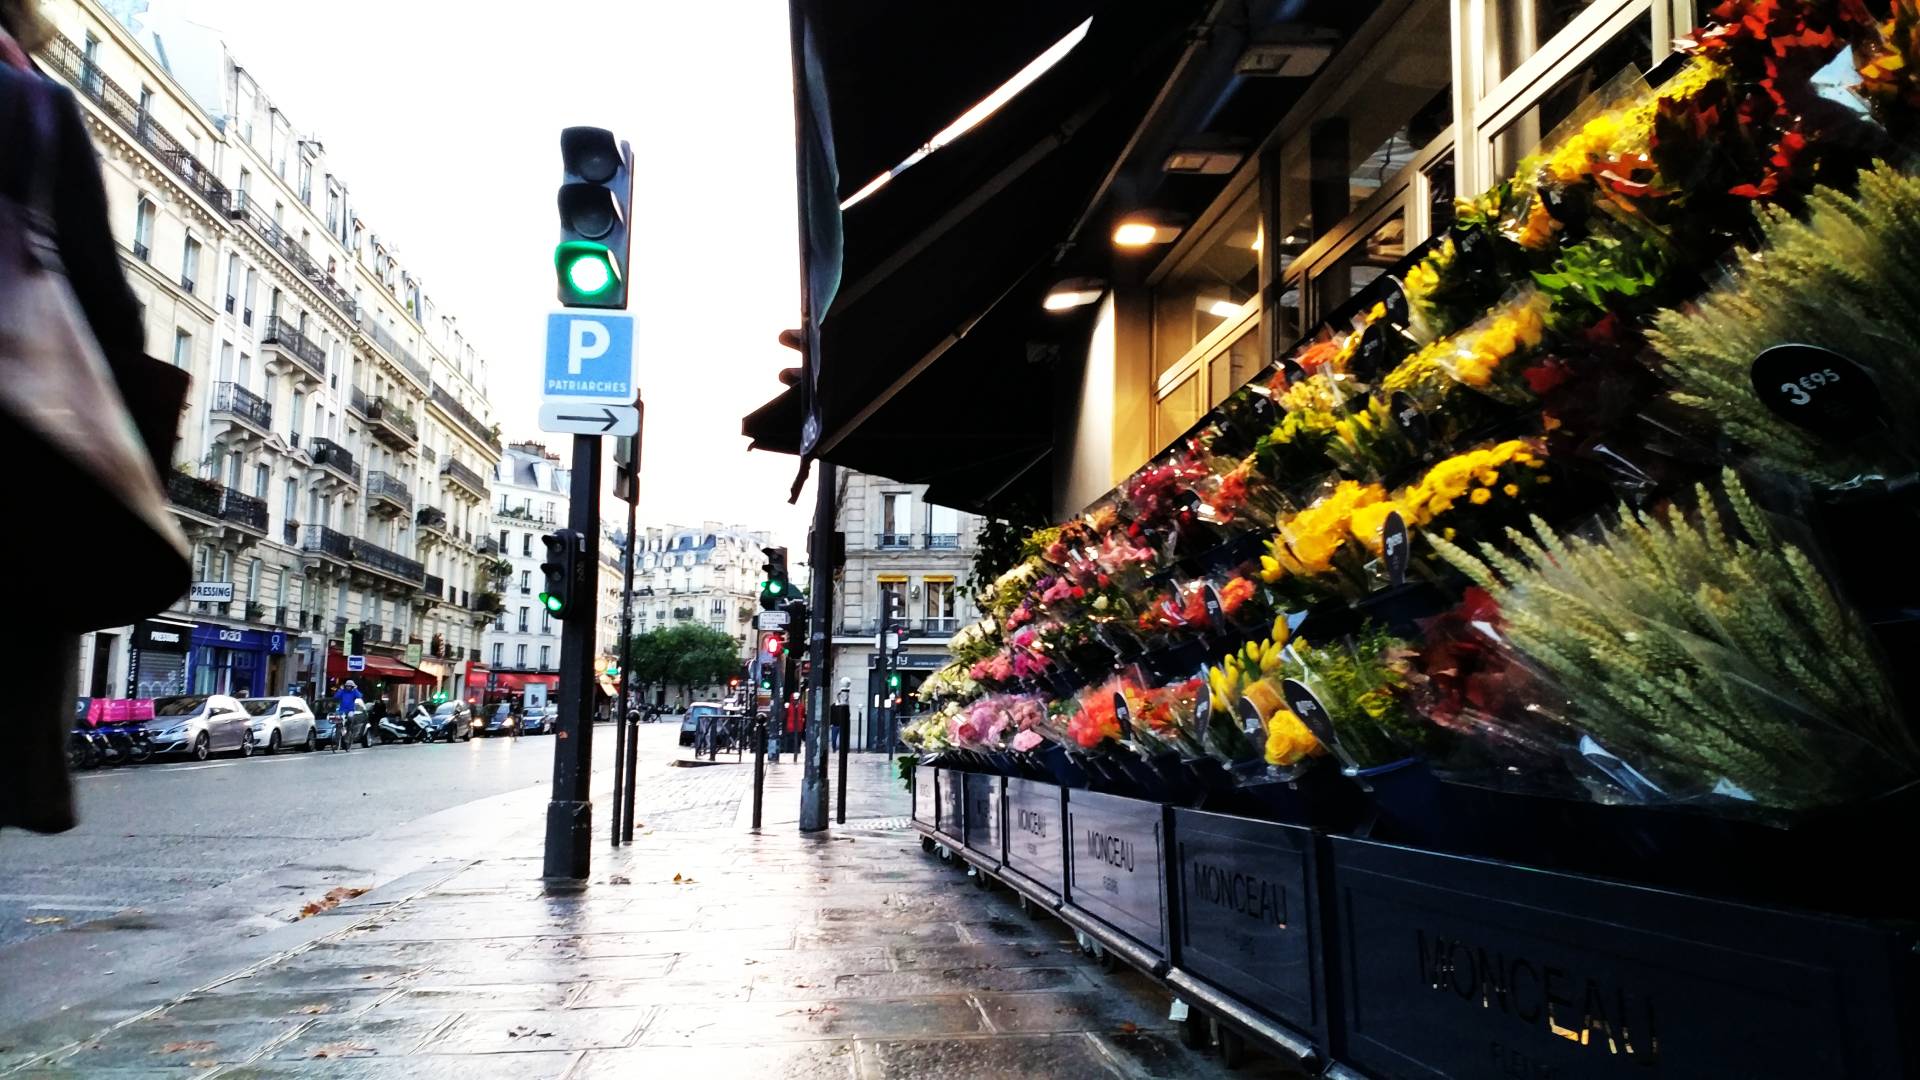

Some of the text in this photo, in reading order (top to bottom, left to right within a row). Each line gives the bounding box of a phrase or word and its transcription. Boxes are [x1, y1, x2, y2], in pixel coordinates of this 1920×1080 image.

[568, 319, 610, 375] P
[548, 380, 626, 393] PATRIARCHES
[191, 586, 231, 597] PRESSING
[1087, 829, 1135, 872] MONCEAU
[1194, 862, 1288, 930] MONCEAU
[1417, 928, 1660, 1066] MONCEAU
